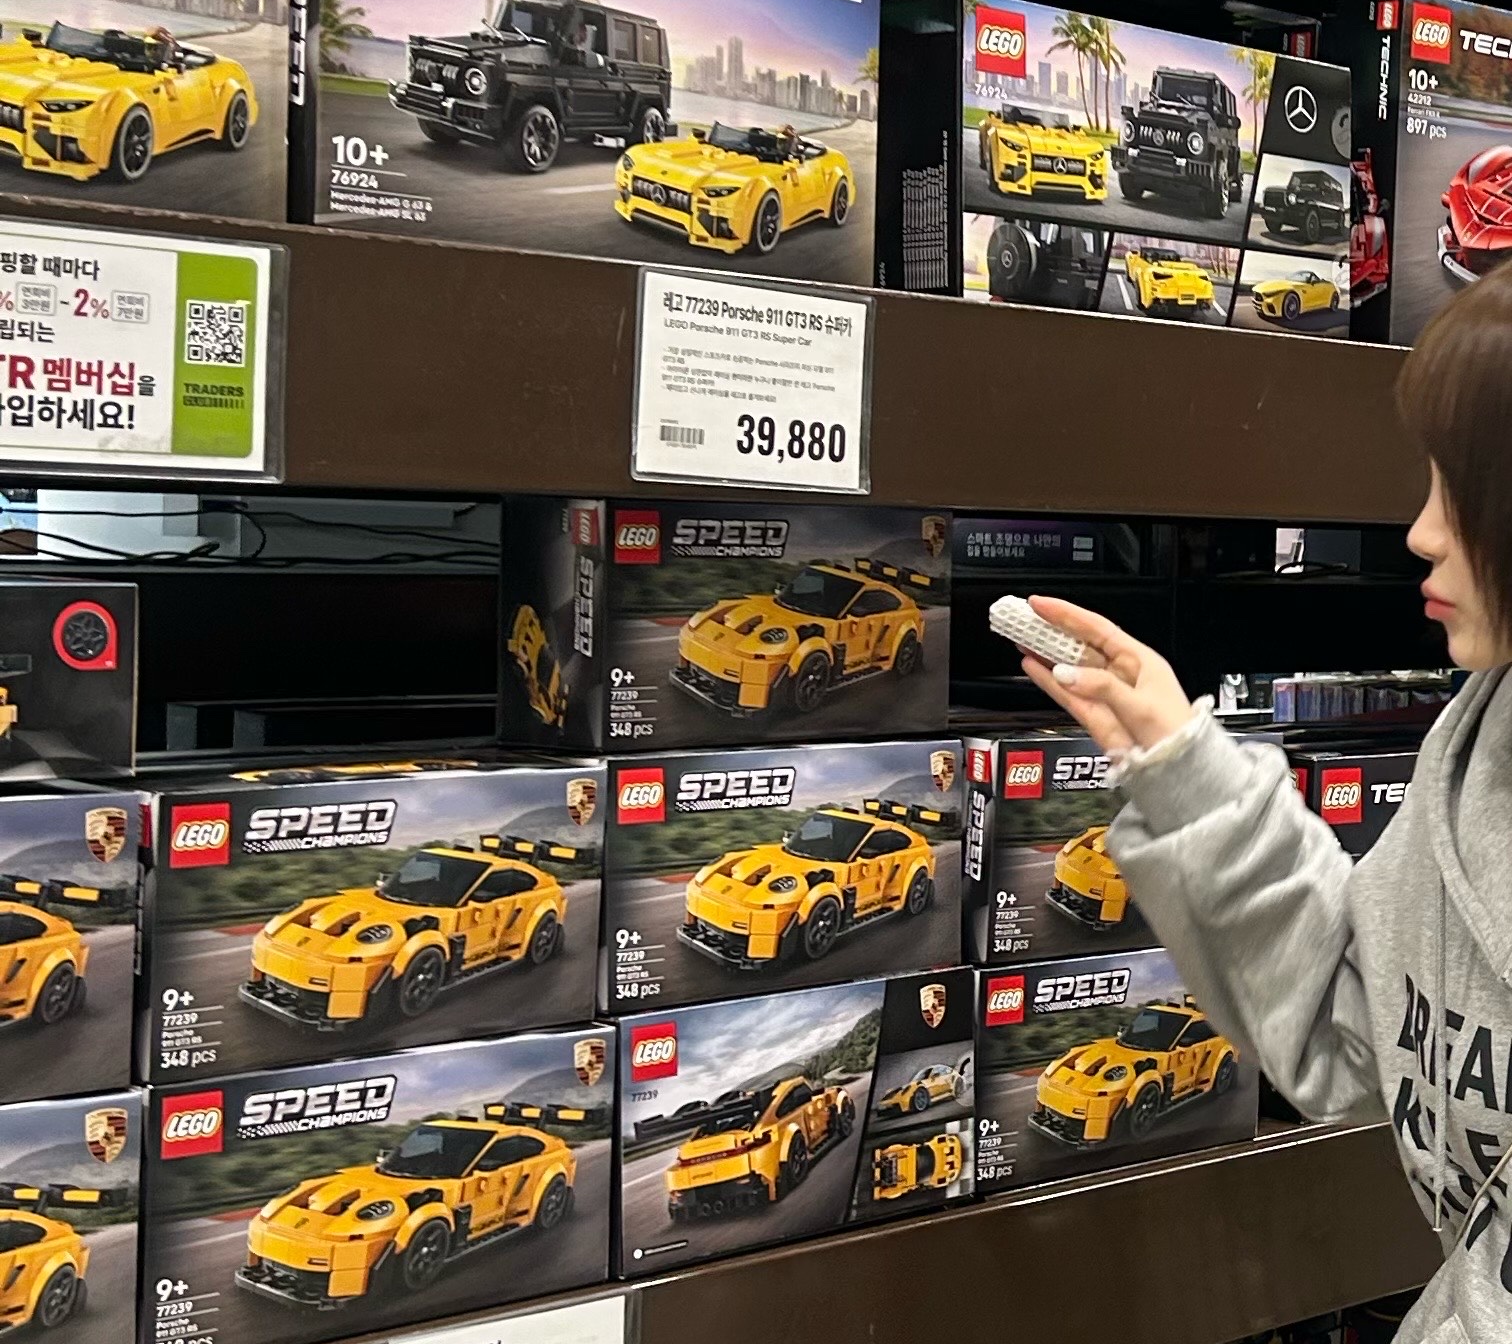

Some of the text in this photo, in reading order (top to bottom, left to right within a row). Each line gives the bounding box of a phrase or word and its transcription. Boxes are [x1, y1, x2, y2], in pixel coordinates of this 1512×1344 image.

[979, 27, 1024, 58] LEGO
[1413, 19, 1450, 48] LEGO
[1378, 36, 1391, 120] TECHNIC
[1408, 69, 1439, 92] 10+
[974, 82, 1009, 101] 76924
[1406, 119, 1447, 140] 897 pcs
[331, 135, 389, 168] 10+
[331, 170, 378, 189] 76924
[43, 256, 100, 281] 때마다
[74, 288, 110, 319] 2%
[663, 292, 823, 331] 레고 77239 Porsche 911 GT3 RS
[664, 318, 812, 347] LEGO Porsche 911 GT3 Super Car
[43, 357, 156, 397] 멤버십을
[184, 383, 244, 397] TRADERS
[736, 414, 846, 464] 39,880
[617, 526, 660, 549] LEGO
[672, 519, 790, 548] SPEED
[578, 557, 594, 657] SPEED
[611, 668, 635, 687] 9+
[610, 690, 639, 701] 77239
[610, 722, 653, 740] 348 pcs
[973, 750, 984, 781] LEGO
[1006, 763, 1042, 784] LEGO
[621, 782, 663, 806] LEGO
[677, 767, 796, 801] SPEED
[1324, 785, 1360, 807] LEGO
[246, 800, 397, 841] SPEED
[174, 824, 228, 849] LEGO
[971, 791, 986, 882] SPEED
[997, 891, 1017, 908] 9+
[616, 929, 641, 947] 9+
[994, 938, 1030, 952] 348 pcs
[616, 951, 645, 962] 77239
[616, 983, 660, 999] 348 pcs
[1034, 968, 1132, 1001] SPEED
[162, 989, 194, 1010] 9+
[987, 989, 1024, 1012] LEGO
[162, 1013, 198, 1027] 77239
[161, 1049, 217, 1069] 348 pcs
[633, 1037, 674, 1064] LEGO
[238, 1075, 398, 1129] SPEED
[631, 1089, 659, 1103] 77239
[162, 1108, 222, 1142] LEGO
[979, 1119, 999, 1136] 9+
[978, 1136, 1002, 1149] 77239
[977, 1164, 1013, 1180] 348 pcs
[156, 1279, 188, 1301] 9+
[156, 1301, 194, 1318] 77239
